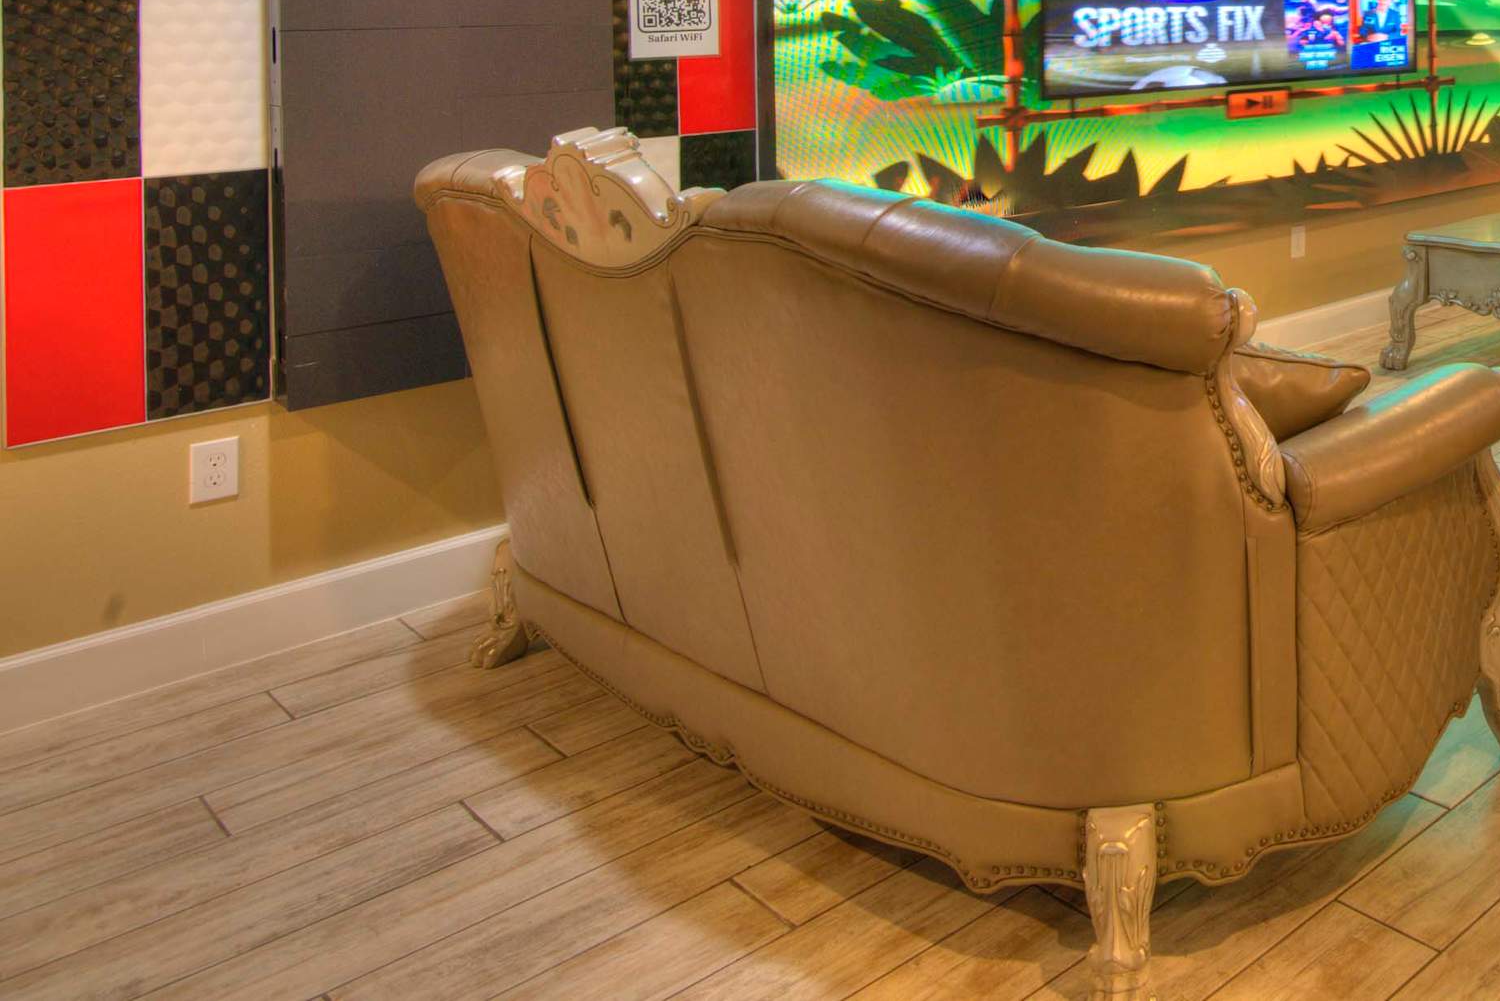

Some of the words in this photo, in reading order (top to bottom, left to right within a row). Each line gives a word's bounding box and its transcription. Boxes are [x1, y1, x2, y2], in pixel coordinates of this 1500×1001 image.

[648, 33, 678, 43] Safari
[680, 32, 703, 41] WiFi
[1073, 6, 1209, 48] SPORTS
[1216, 5, 1266, 42] FIX
